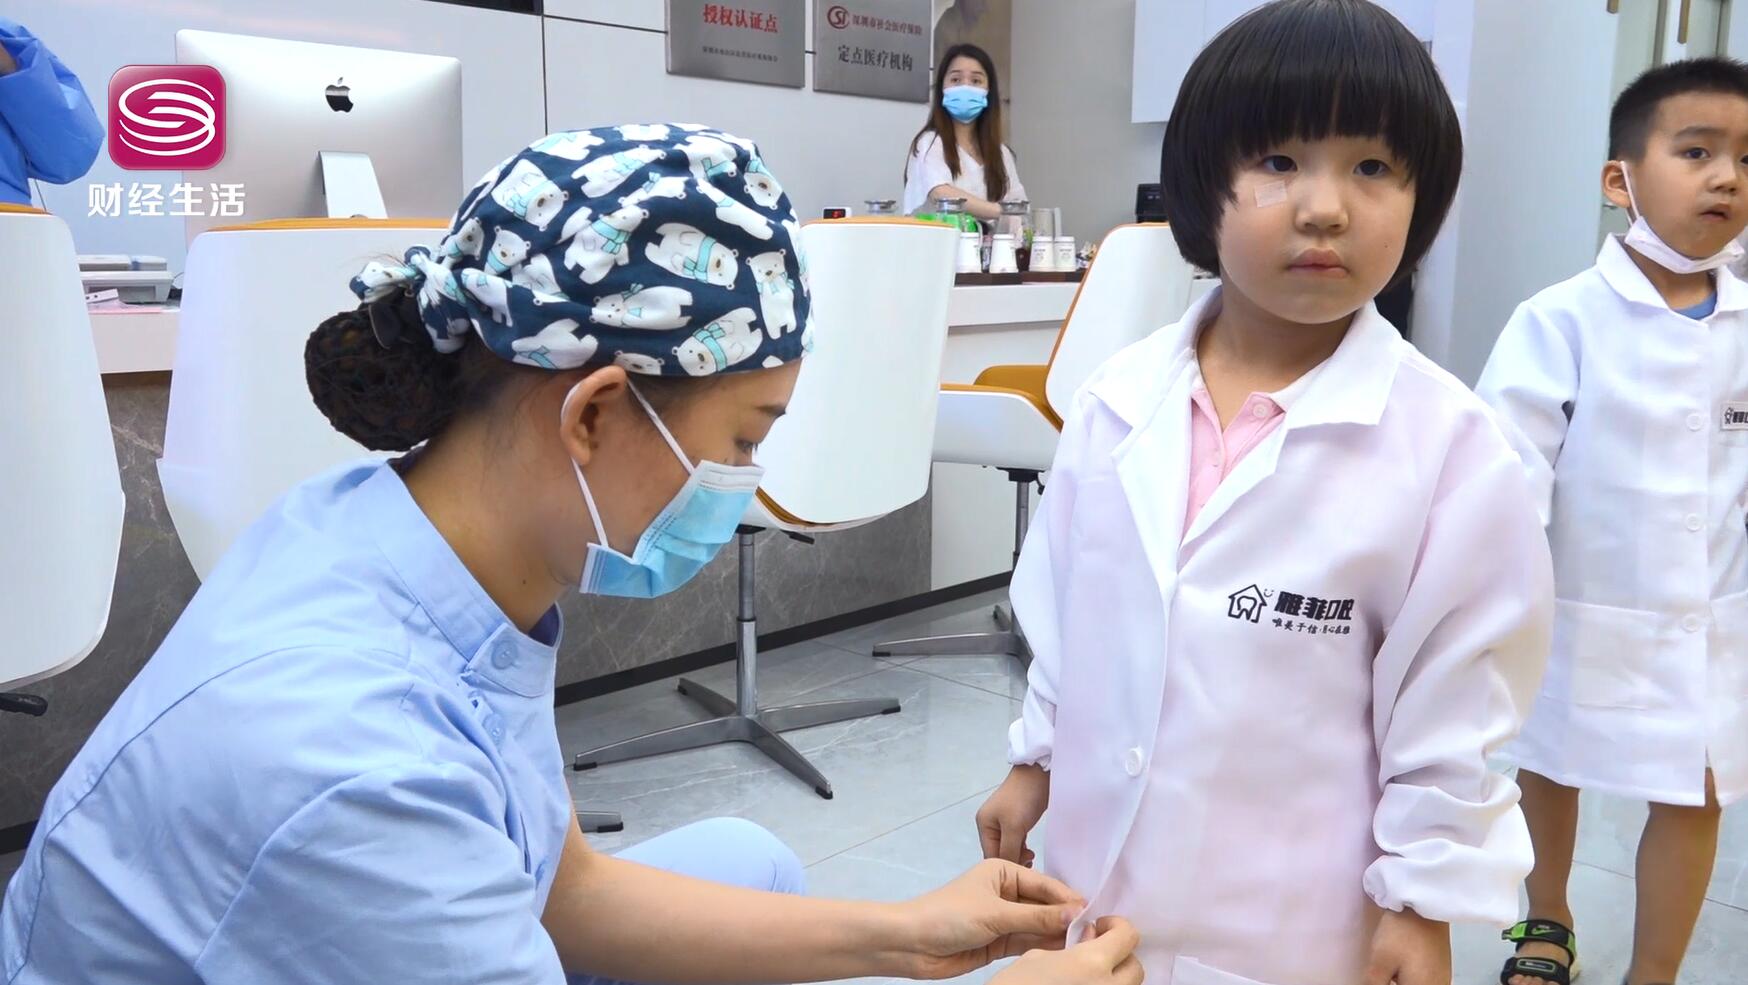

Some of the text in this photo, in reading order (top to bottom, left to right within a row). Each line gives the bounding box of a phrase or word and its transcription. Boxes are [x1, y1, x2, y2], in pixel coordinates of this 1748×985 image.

[703, 4, 778, 33] 授权认证点
[838, 44, 913, 72] 定点医疗机构
